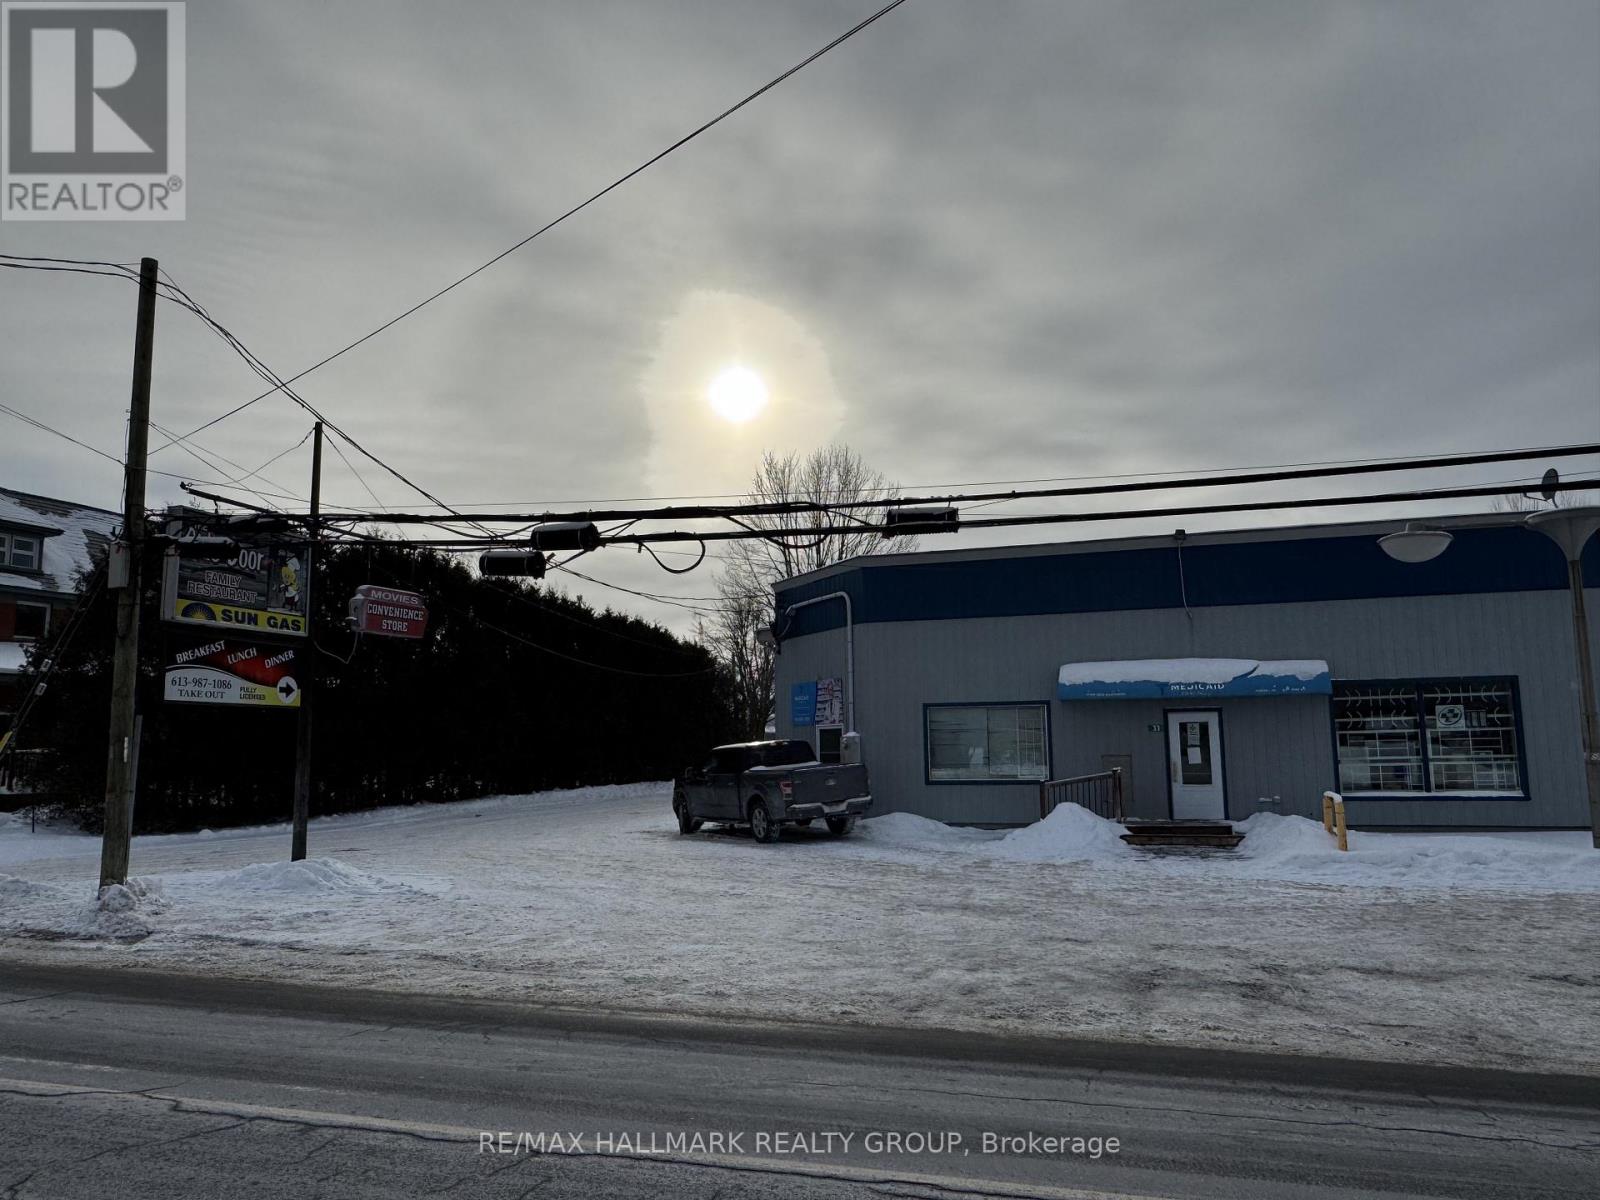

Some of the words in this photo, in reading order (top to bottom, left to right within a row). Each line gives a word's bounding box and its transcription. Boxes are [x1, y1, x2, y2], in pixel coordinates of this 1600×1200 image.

[205, 570, 242, 587] FAMILY
[186, 580, 258, 603] RESTAURANT
[371, 590, 419, 605] MOVIES
[221, 608, 258, 626] SUN
[266, 615, 302, 632] GAS
[367, 603, 425, 621] CONVENIENCE
[382, 619, 409, 632] STORE
[175, 639, 226, 664] BREAKFAST
[227, 647, 258, 665] LUNCH
[264, 650, 295, 669] DINNER
[171, 676, 232, 690] 613-987-1086
[178, 688, 205, 698] TAKE
[205, 690, 226, 699] OUT
